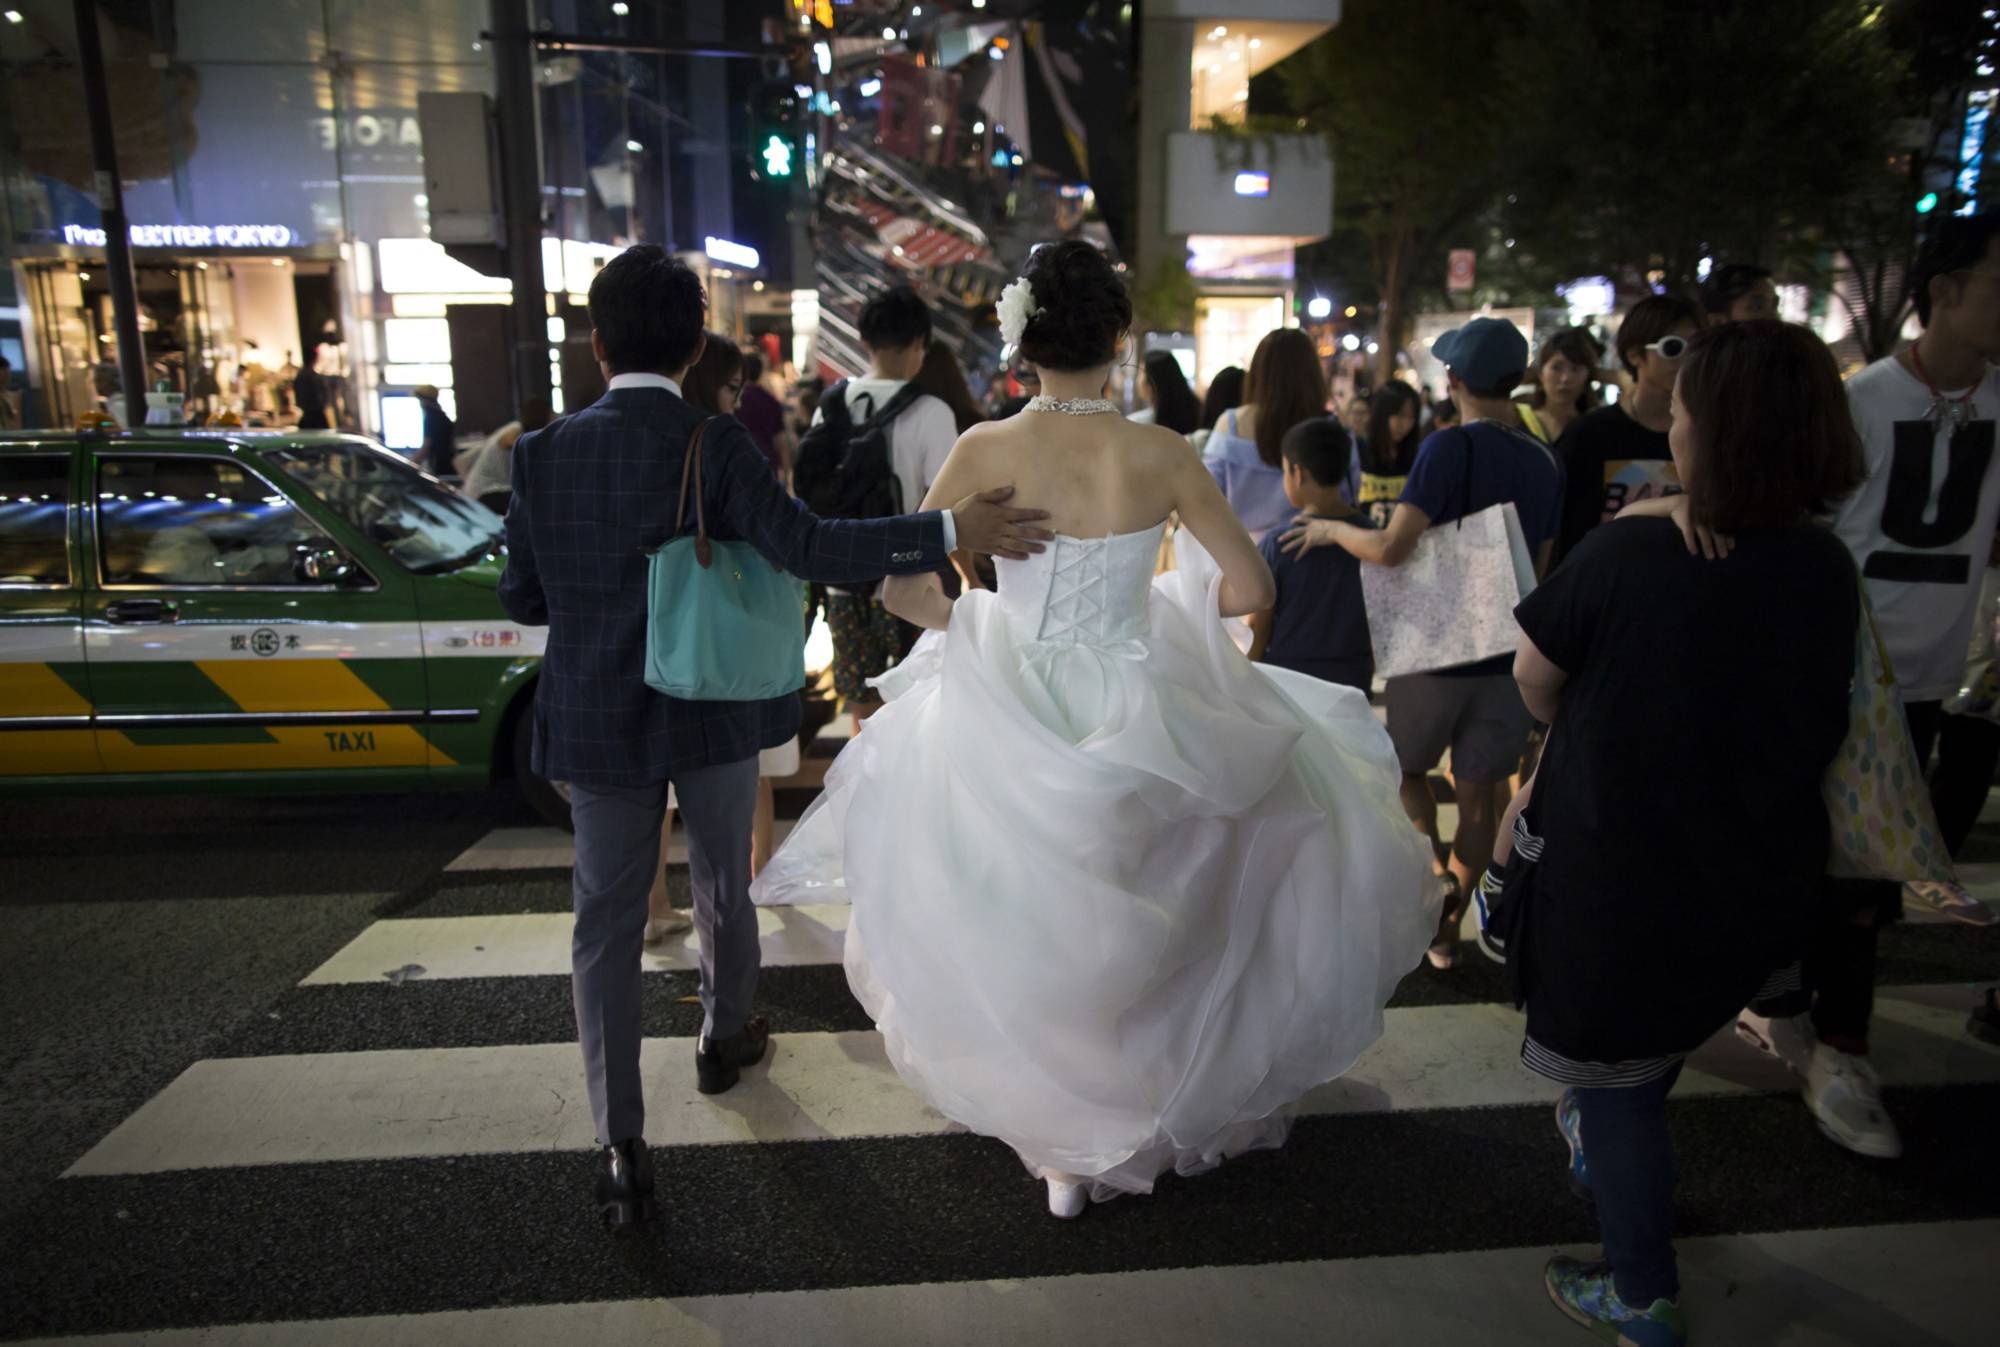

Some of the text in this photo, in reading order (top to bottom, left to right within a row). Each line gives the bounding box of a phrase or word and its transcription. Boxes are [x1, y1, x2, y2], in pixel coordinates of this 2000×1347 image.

[214, 225, 291, 247] TOKYO
[1880, 419, 1996, 549] U
[323, 731, 376, 752] TAXI
